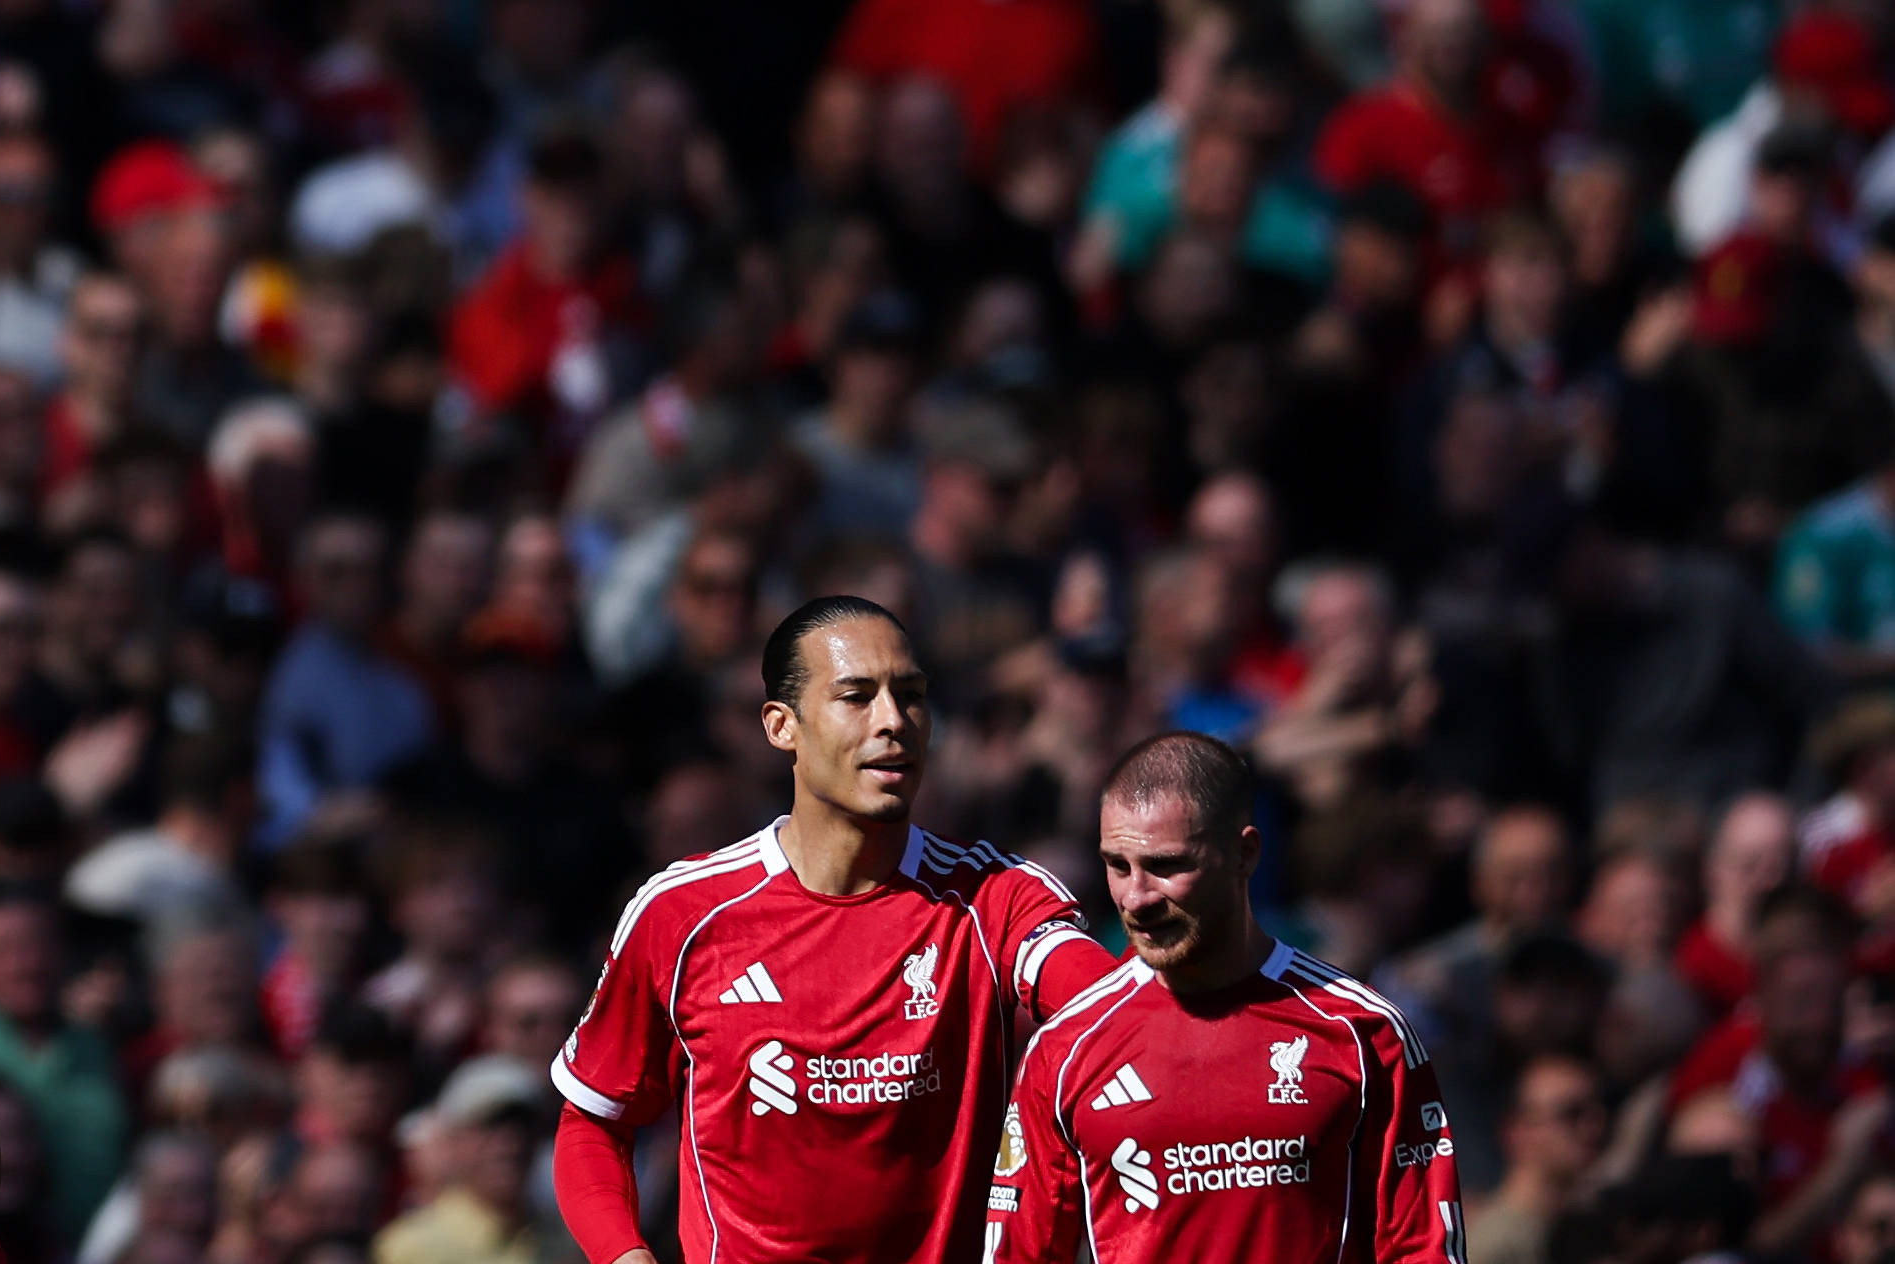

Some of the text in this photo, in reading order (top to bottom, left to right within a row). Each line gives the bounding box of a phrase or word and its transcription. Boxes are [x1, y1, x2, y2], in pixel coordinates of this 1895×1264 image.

[806, 1047, 933, 1079] standard
[807, 1069, 941, 1104] chartered
[1163, 1134, 1305, 1170] standard
[1167, 1159, 1310, 1195] chartered
